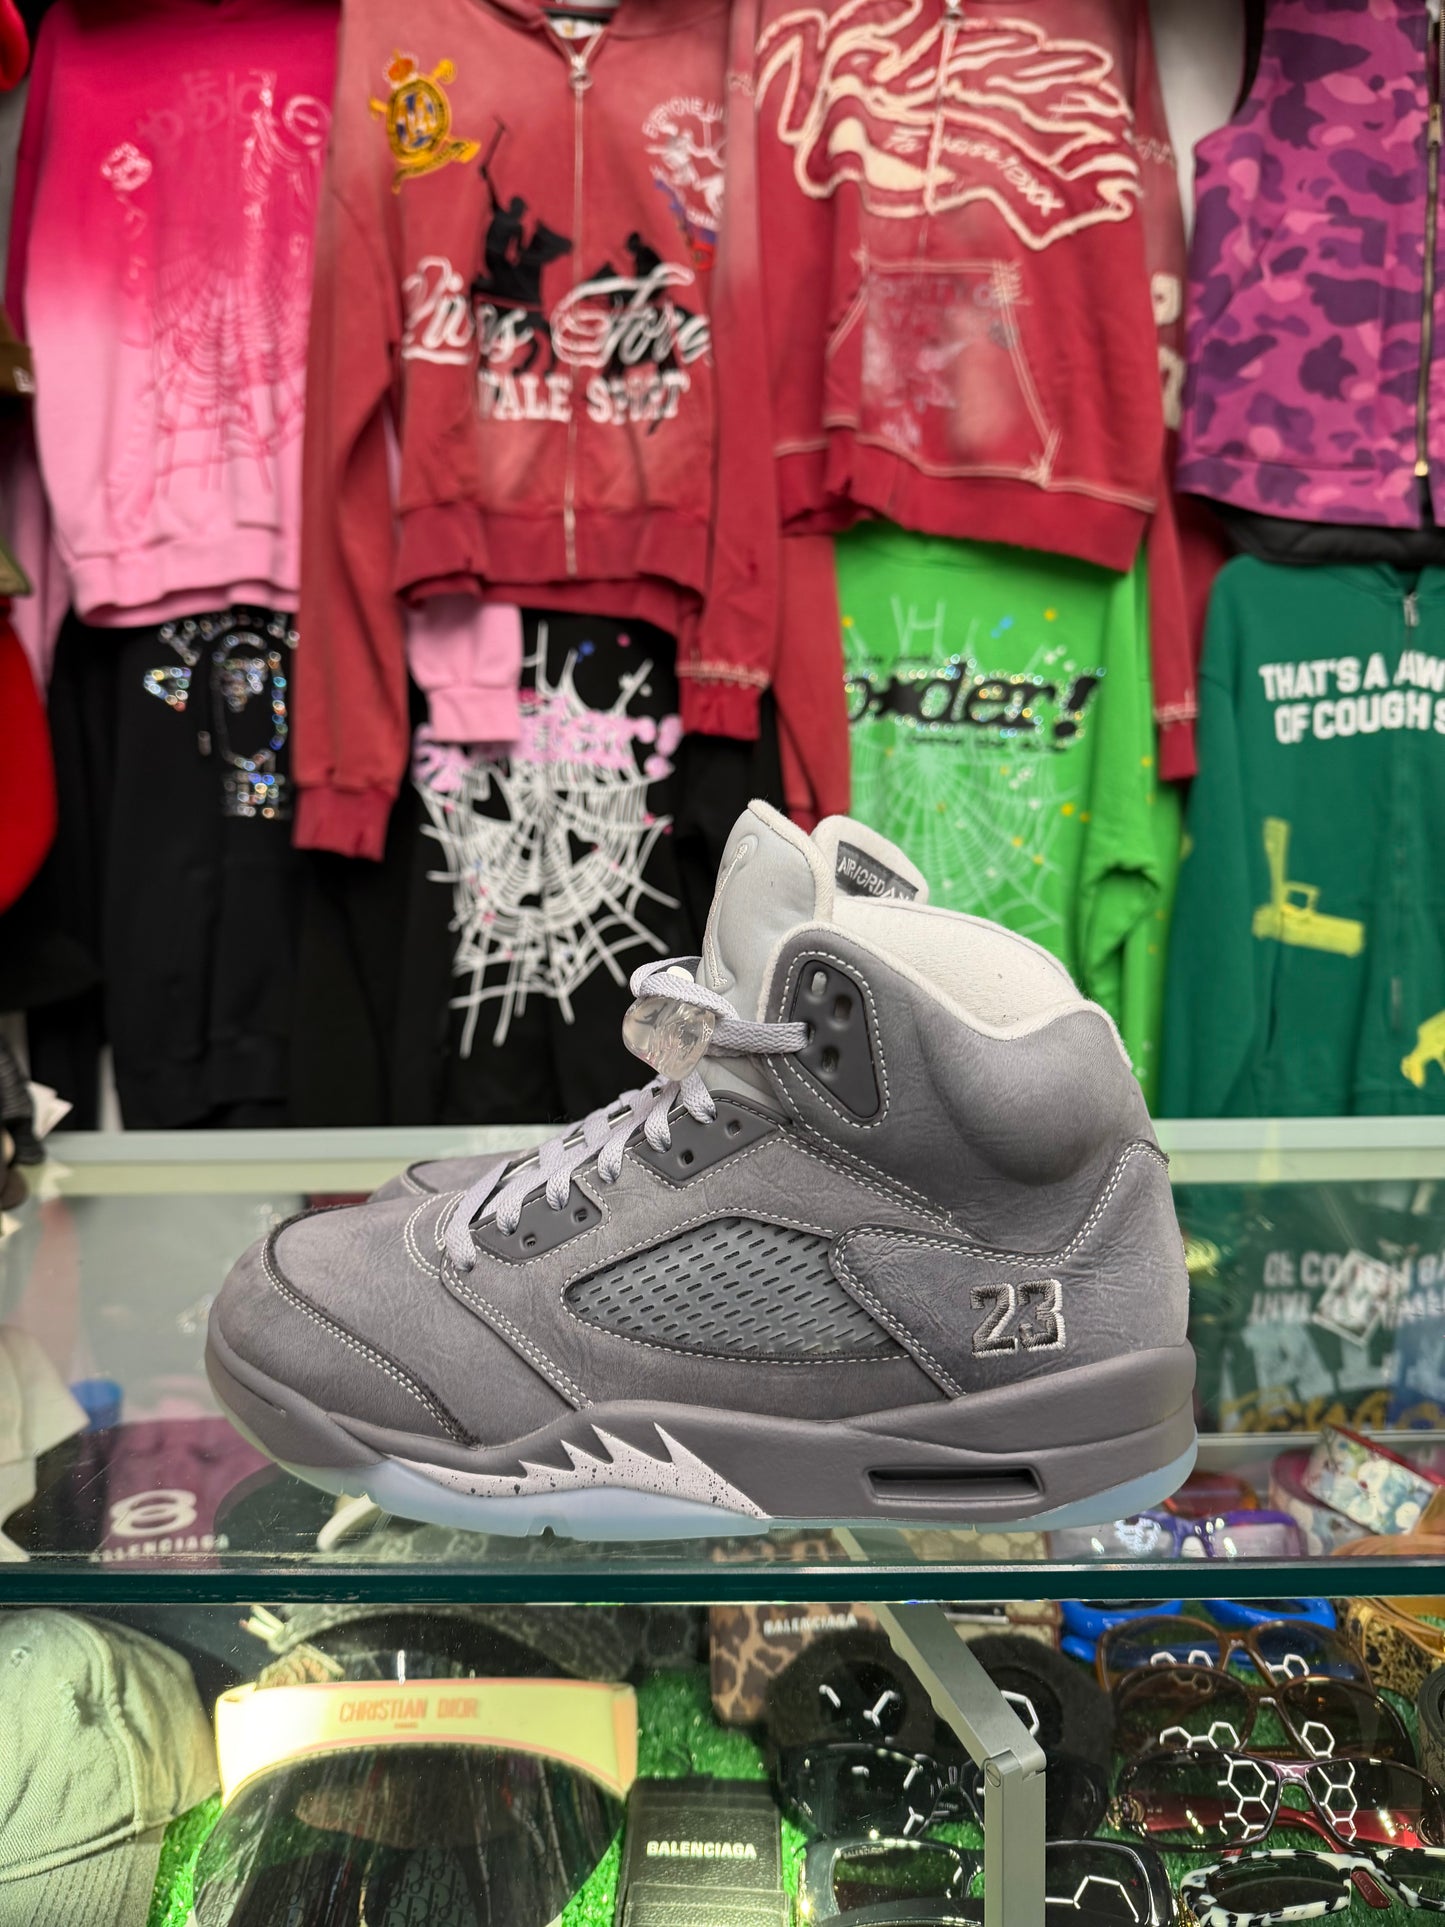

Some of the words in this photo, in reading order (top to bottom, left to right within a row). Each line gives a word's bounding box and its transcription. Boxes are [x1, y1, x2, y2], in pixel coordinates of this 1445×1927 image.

[1258, 658, 1362, 702] THAT'S
[1362, 652, 1389, 690] A
[1274, 703, 1310, 744] OF
[1312, 690, 1432, 740] COUGH
[970, 1278, 1066, 1358] 23
[339, 1698, 428, 1723] CHRISTIAN
[437, 1697, 479, 1719] DIOR
[646, 1839, 758, 1860] BALENCIAGA
